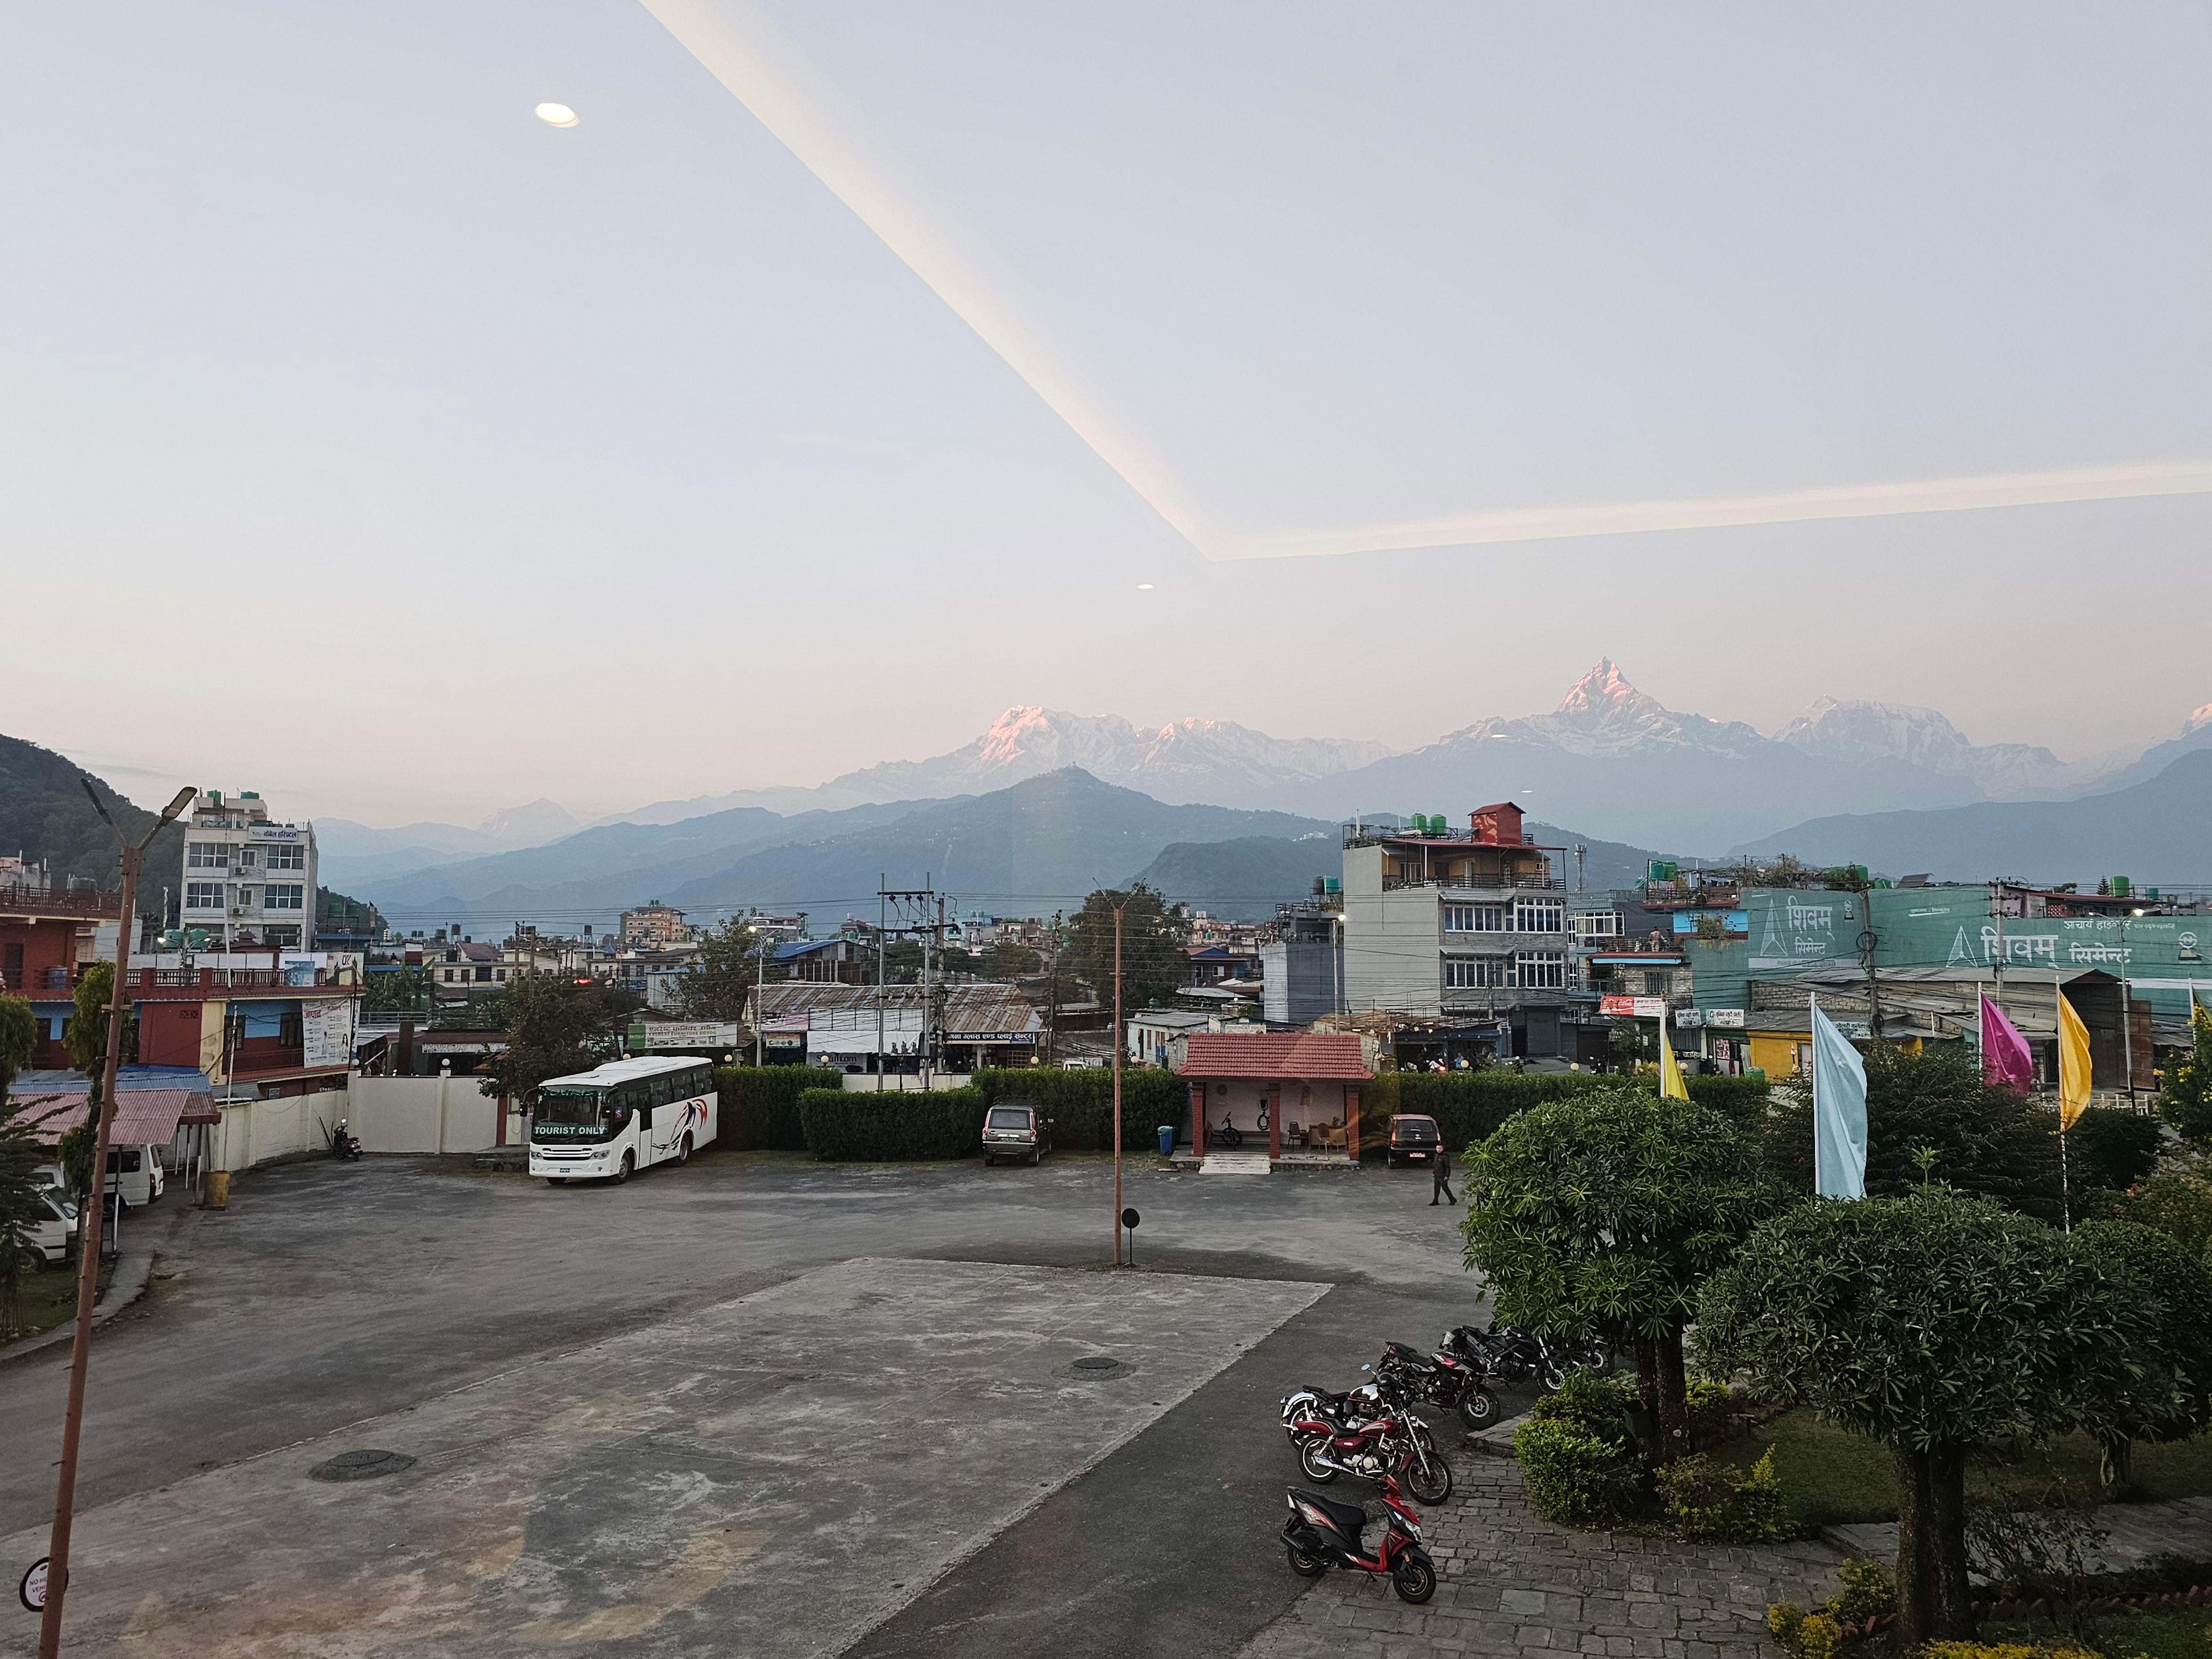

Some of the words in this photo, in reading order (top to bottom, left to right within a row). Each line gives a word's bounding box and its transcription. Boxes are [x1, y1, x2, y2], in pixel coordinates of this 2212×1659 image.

[1786, 895, 1835, 941] शिवम्
[1794, 937, 1827, 955] सिमेन्ट
[1981, 926, 2059, 969] शिवम्
[2069, 942, 2132, 963] सिमेन्ट
